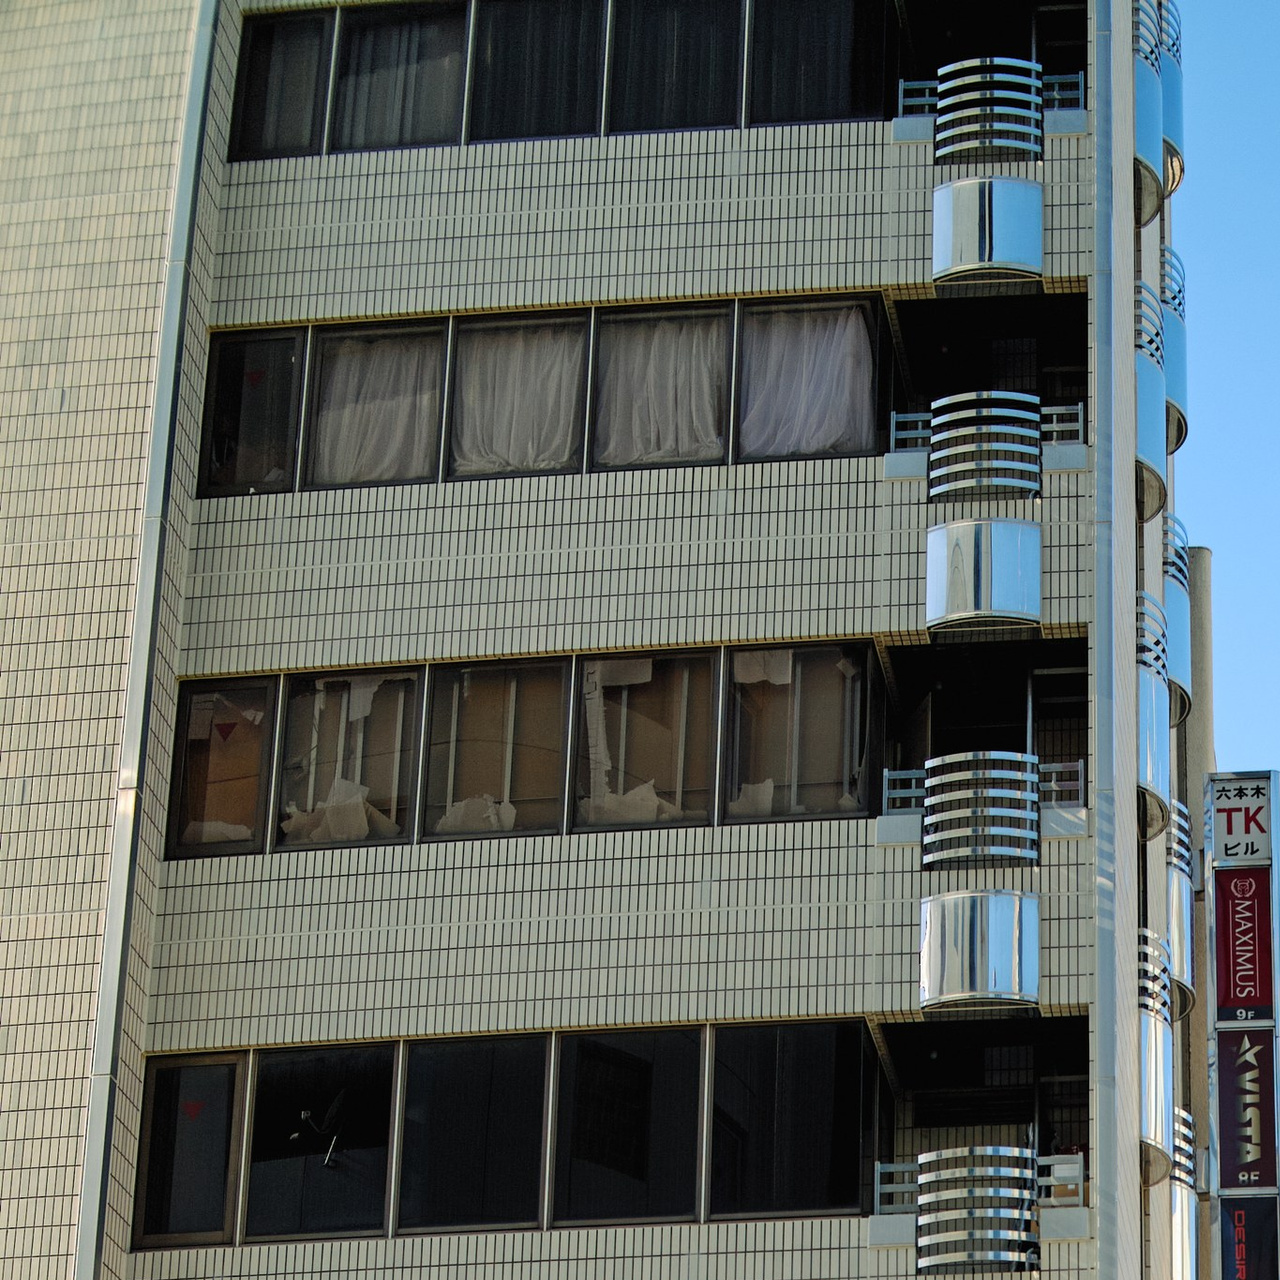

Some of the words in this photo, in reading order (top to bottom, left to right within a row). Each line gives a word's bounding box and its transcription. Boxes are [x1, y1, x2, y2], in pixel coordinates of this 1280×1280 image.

[1216, 785, 1267, 801] 六本木
[1217, 806, 1267, 835] TK
[1224, 841, 1260, 857] ビル
[1234, 899, 1256, 998] MAXIMUS
[1236, 1008, 1255, 1020] 9F
[1238, 1071, 1262, 1165] VISTA
